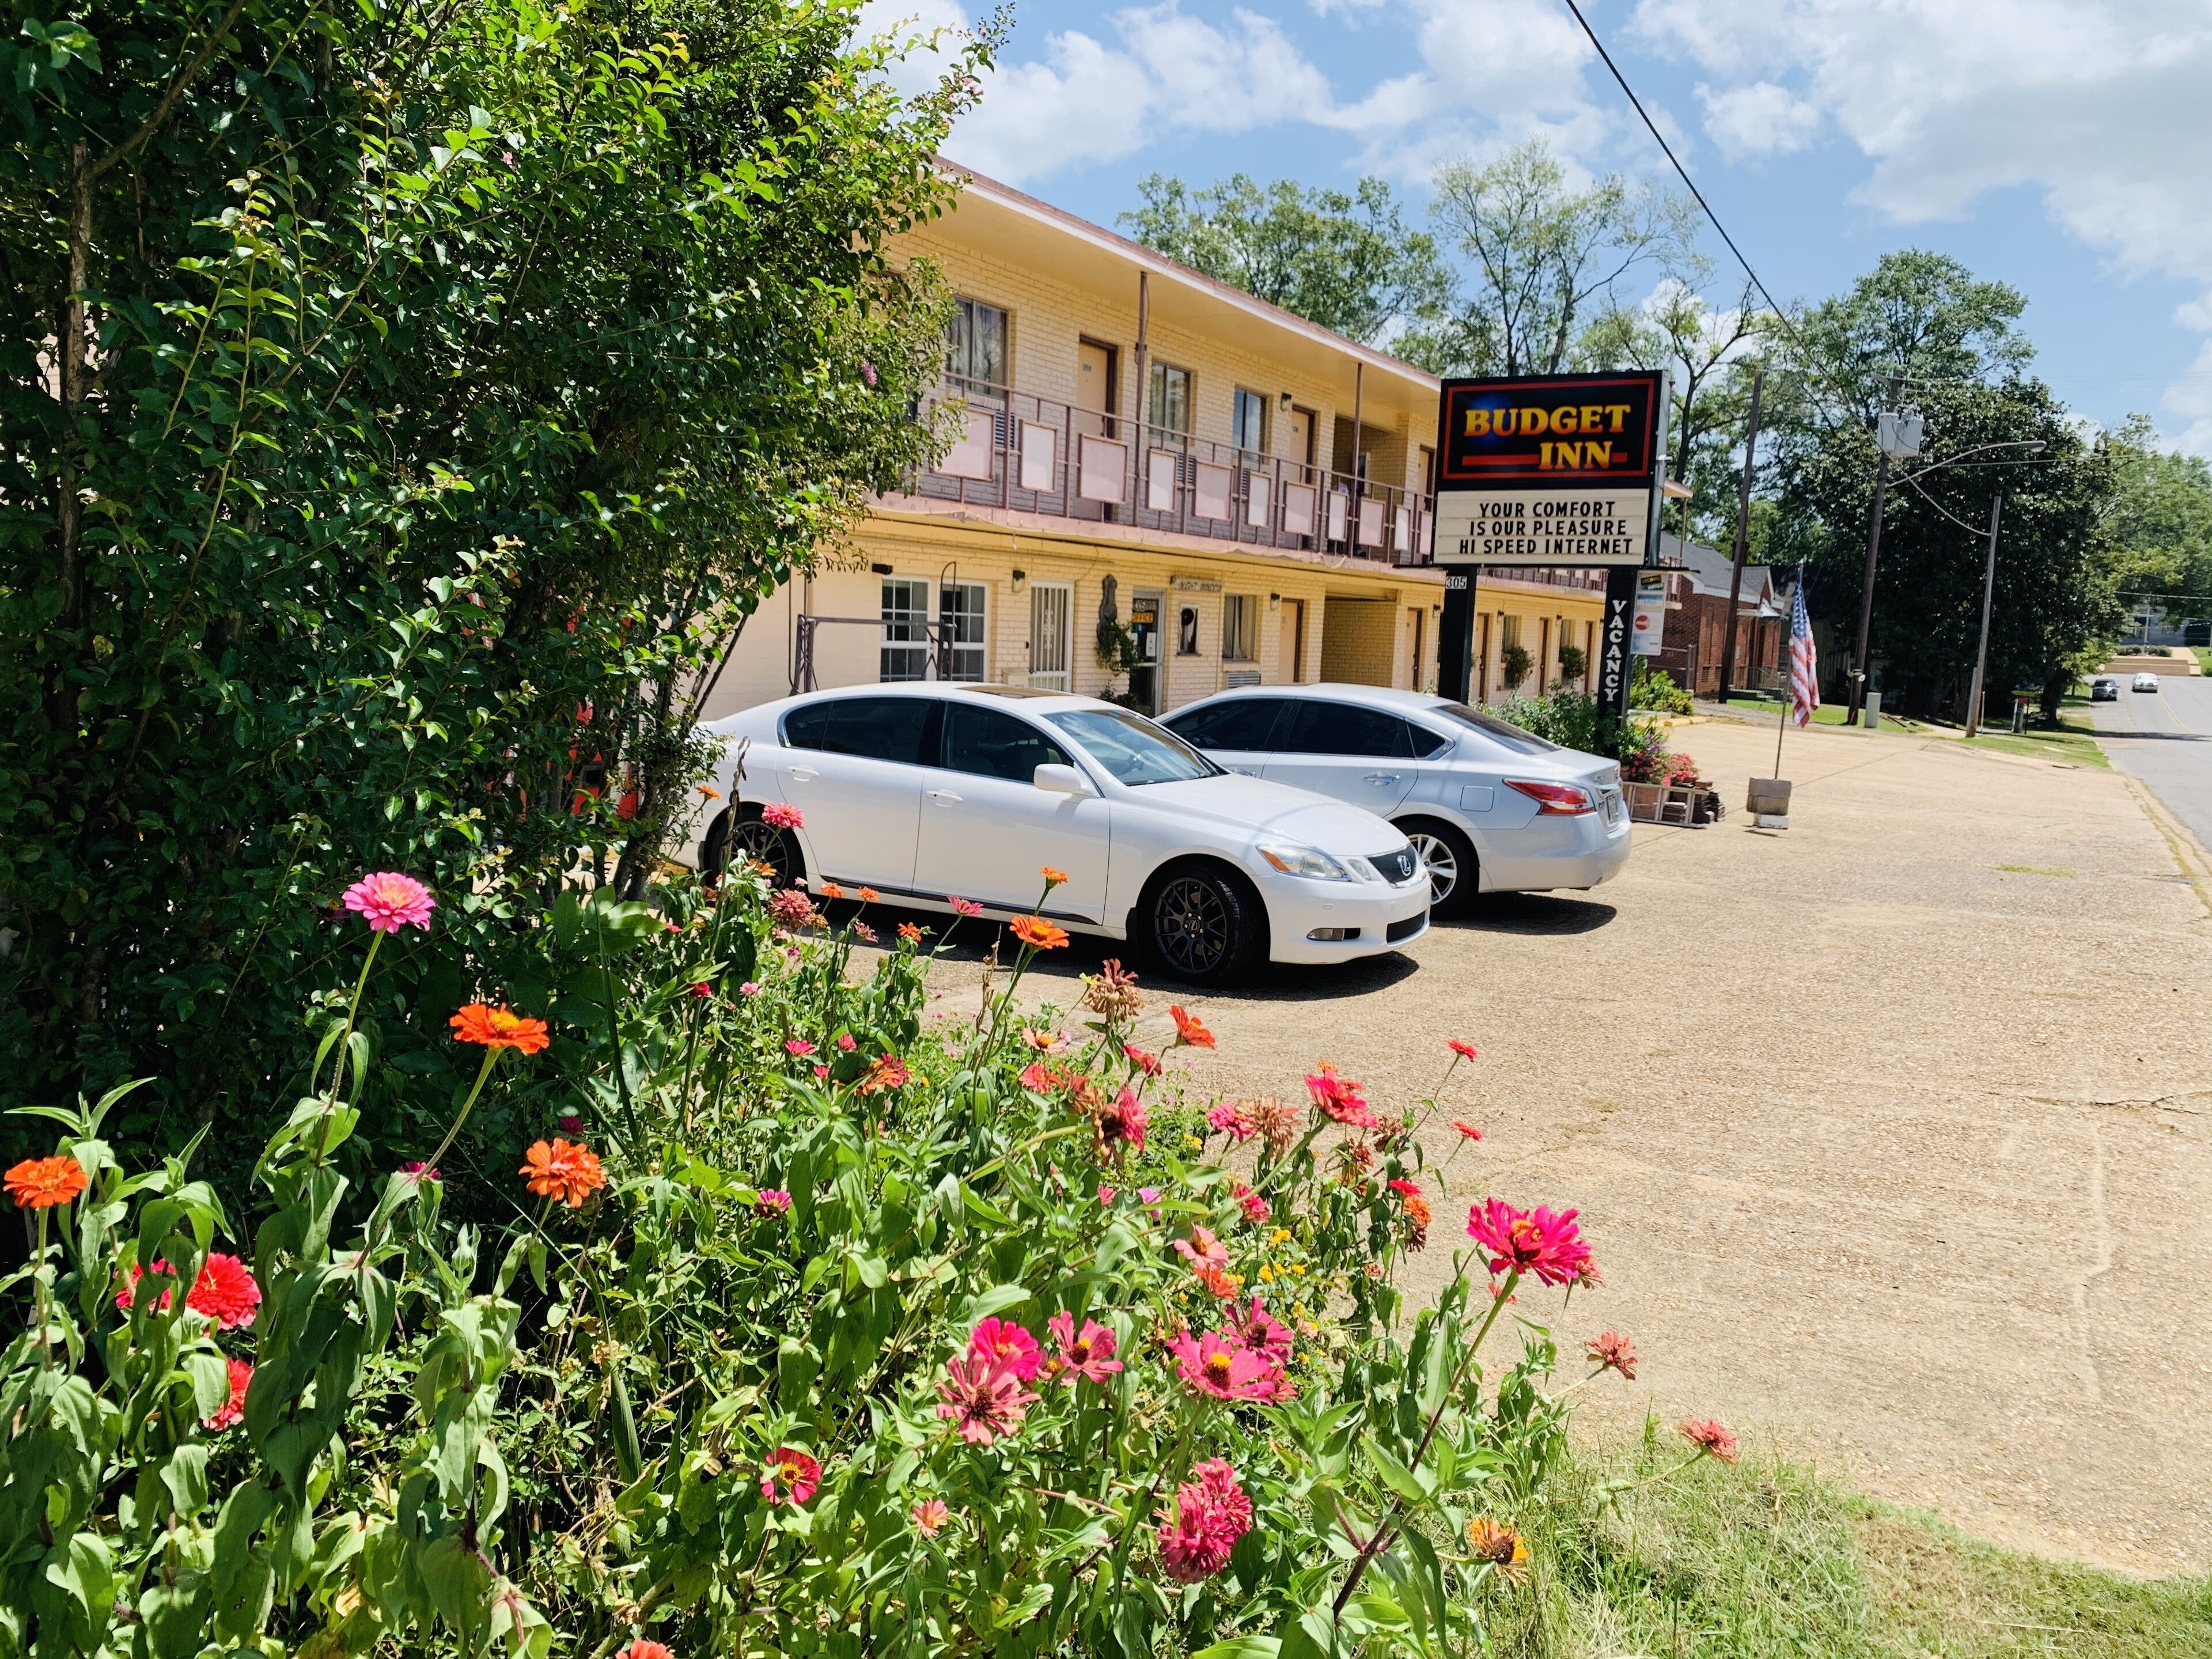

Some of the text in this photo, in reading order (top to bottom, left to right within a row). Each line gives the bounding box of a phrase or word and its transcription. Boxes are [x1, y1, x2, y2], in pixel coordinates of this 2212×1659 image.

[1464, 405, 1631, 436] BUDGET
[1539, 441, 1613, 469] INN
[1479, 501, 1615, 517] YOUR COMFORT
[1469, 520, 1627, 536] IS OUR PLEASURE
[1460, 538, 1633, 554] HI SPEED INTERNET
[1446, 577, 1466, 588] 305
[1604, 599, 1628, 702] VACANCY
